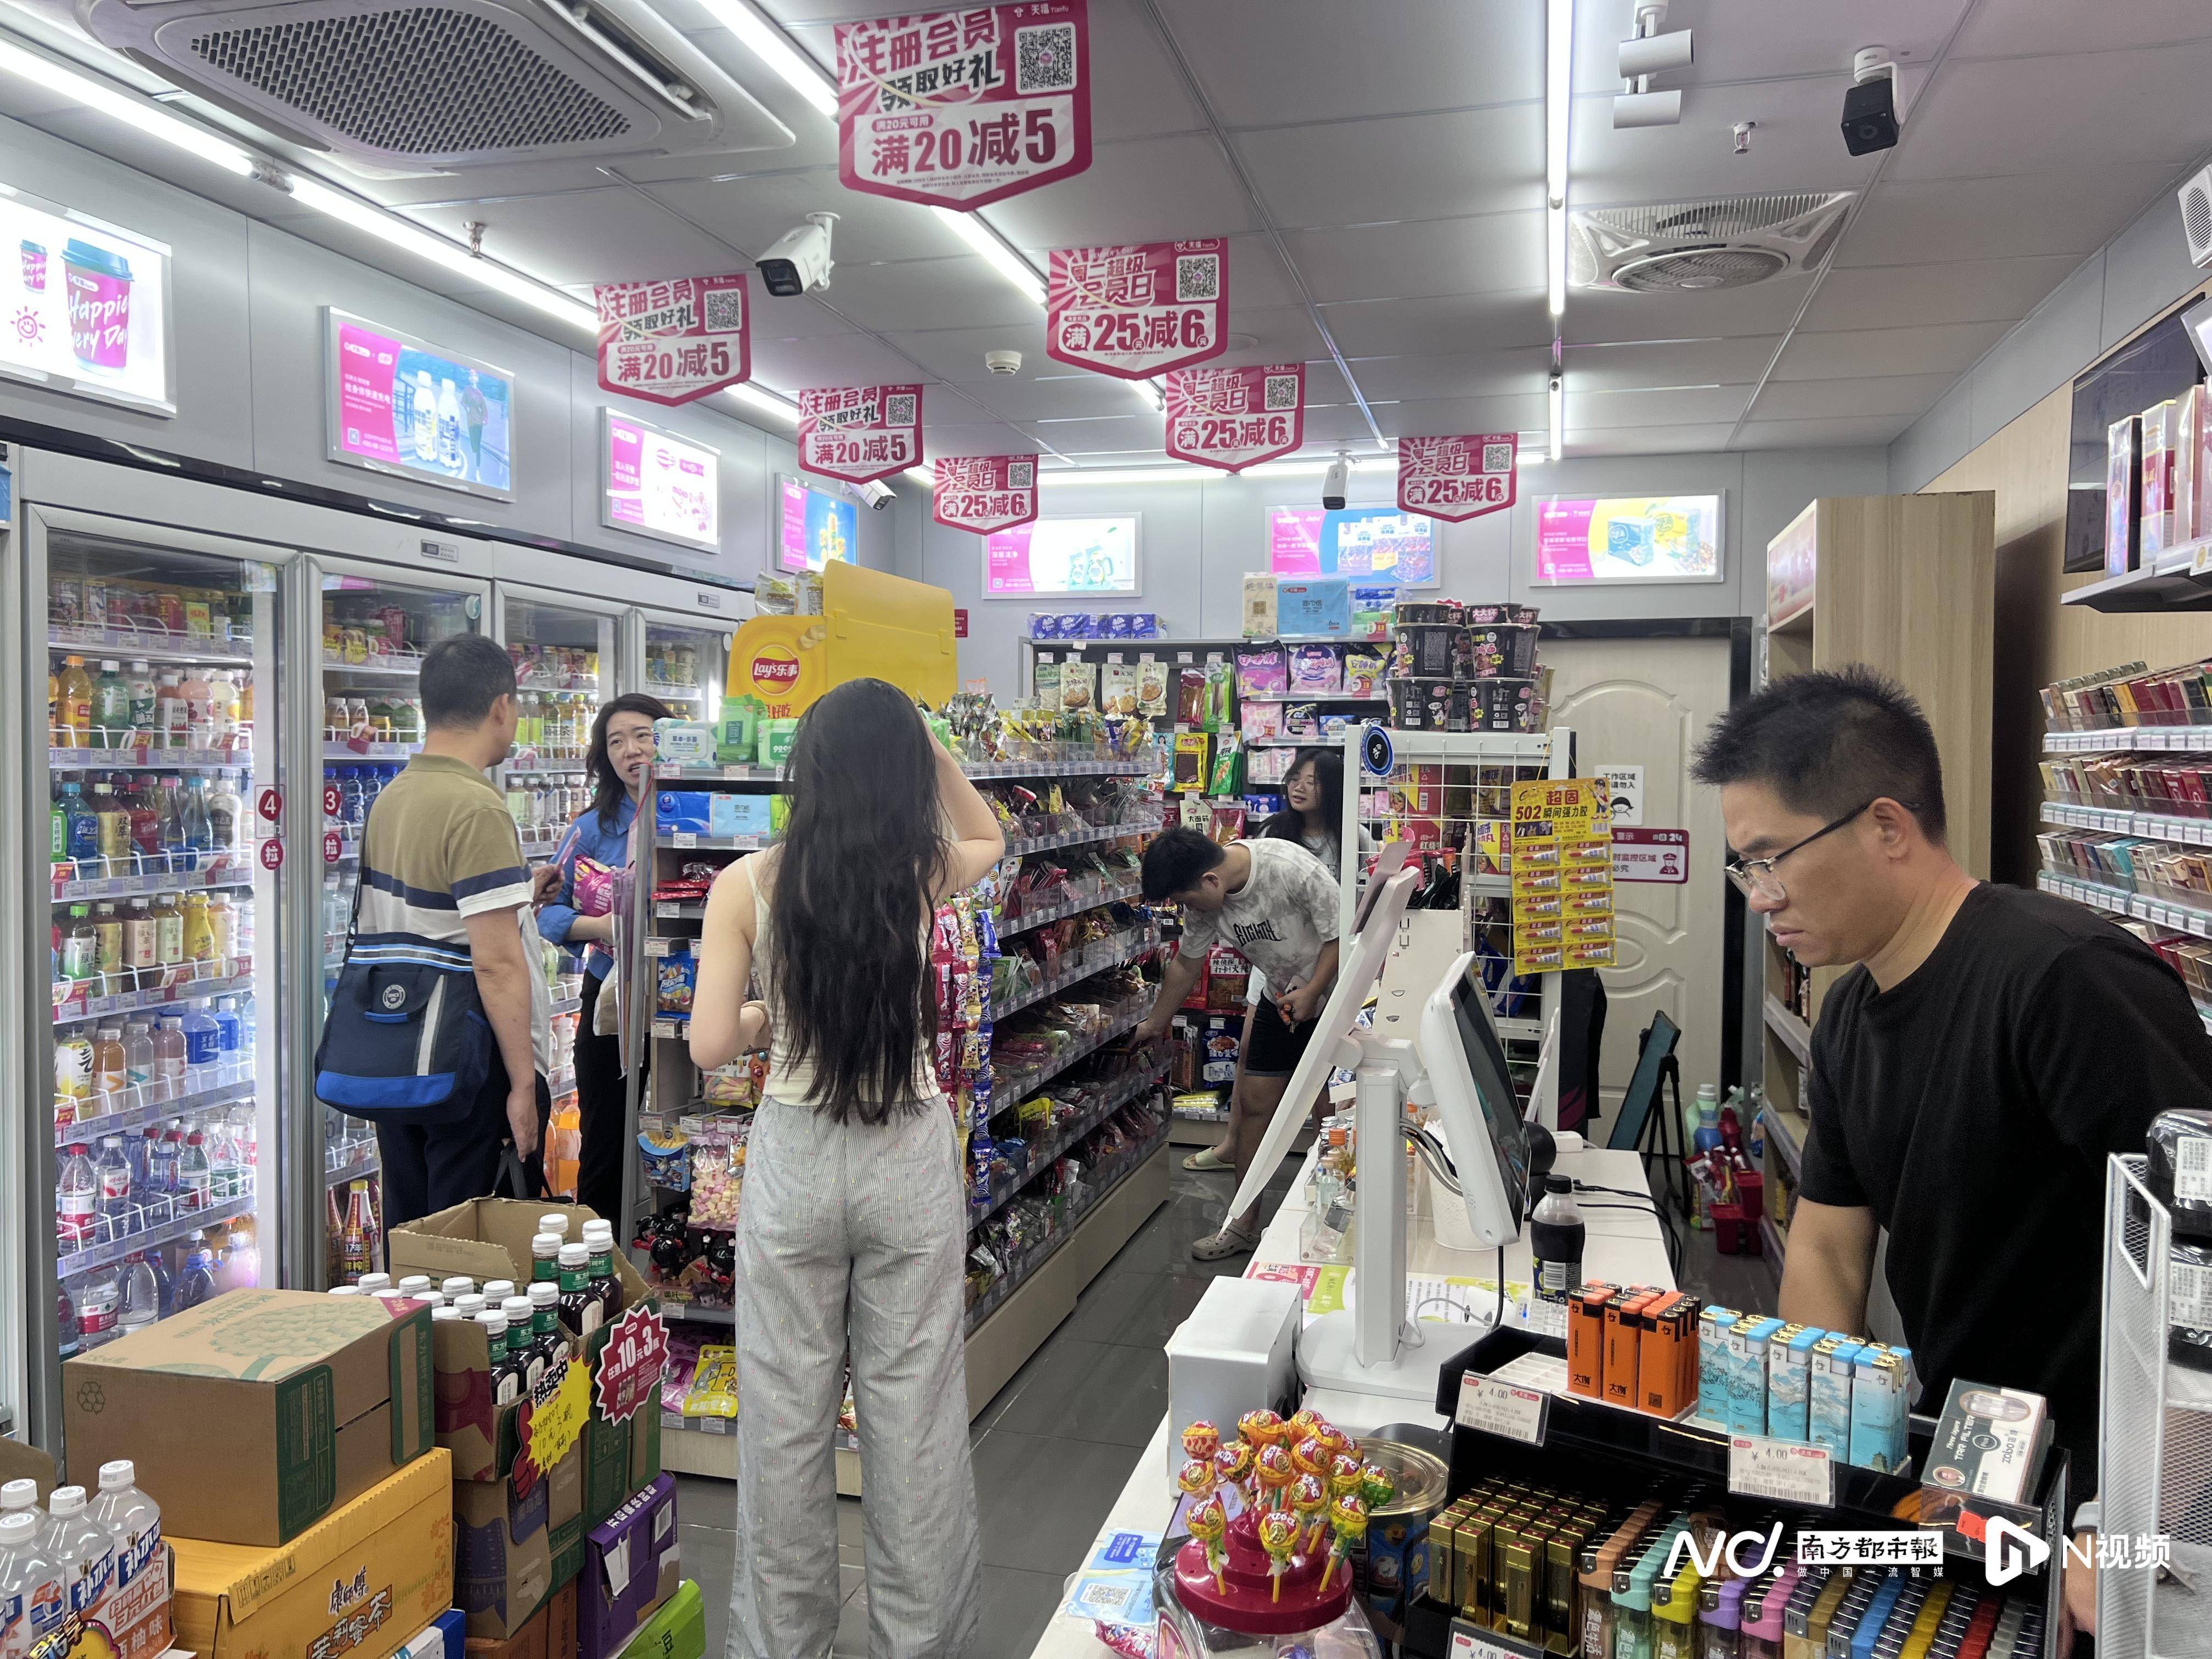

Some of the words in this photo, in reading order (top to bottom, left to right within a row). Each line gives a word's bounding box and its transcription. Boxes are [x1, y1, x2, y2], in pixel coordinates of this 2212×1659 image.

[1031, 4, 1049, 15] 天福
[843, 9, 996, 83] 注册会员
[880, 50, 1001, 111] 领取好礼
[876, 119, 929, 131] 满20元可用
[871, 109, 1057, 177] 满20减5
[602, 279, 693, 320] 注册会员
[1079, 275, 1152, 304] 会员日
[623, 304, 697, 342] 领取好礼
[618, 341, 730, 382] 满20减5
[803, 388, 878, 417] 注册会员
[819, 404, 880, 431] 领取好礼
[815, 434, 907, 464] 满20减5
[753, 662, 777, 678] Lay's
[777, 664, 799, 676] 乐事
[264, 794, 276, 815] 4
[325, 791, 336, 811] 3
[1545, 789, 1579, 806] 超固
[1515, 805, 1542, 821] 502
[1542, 806, 1588, 819] 瞬间强力胶
[265, 845, 279, 863] 拉
[325, 839, 338, 856] 拉
[1489, 1386, 1508, 1400] 4.00
[1954, 1442, 1968, 1462] TAR
[1963, 1414, 1976, 1443] FILTER
[1765, 1448, 1787, 1460] 4.00
[2001, 1442, 2016, 1465] zobo
[329, 1565, 368, 1616] 康师傅
[312, 1591, 392, 1659] 茉莉蜜茶
